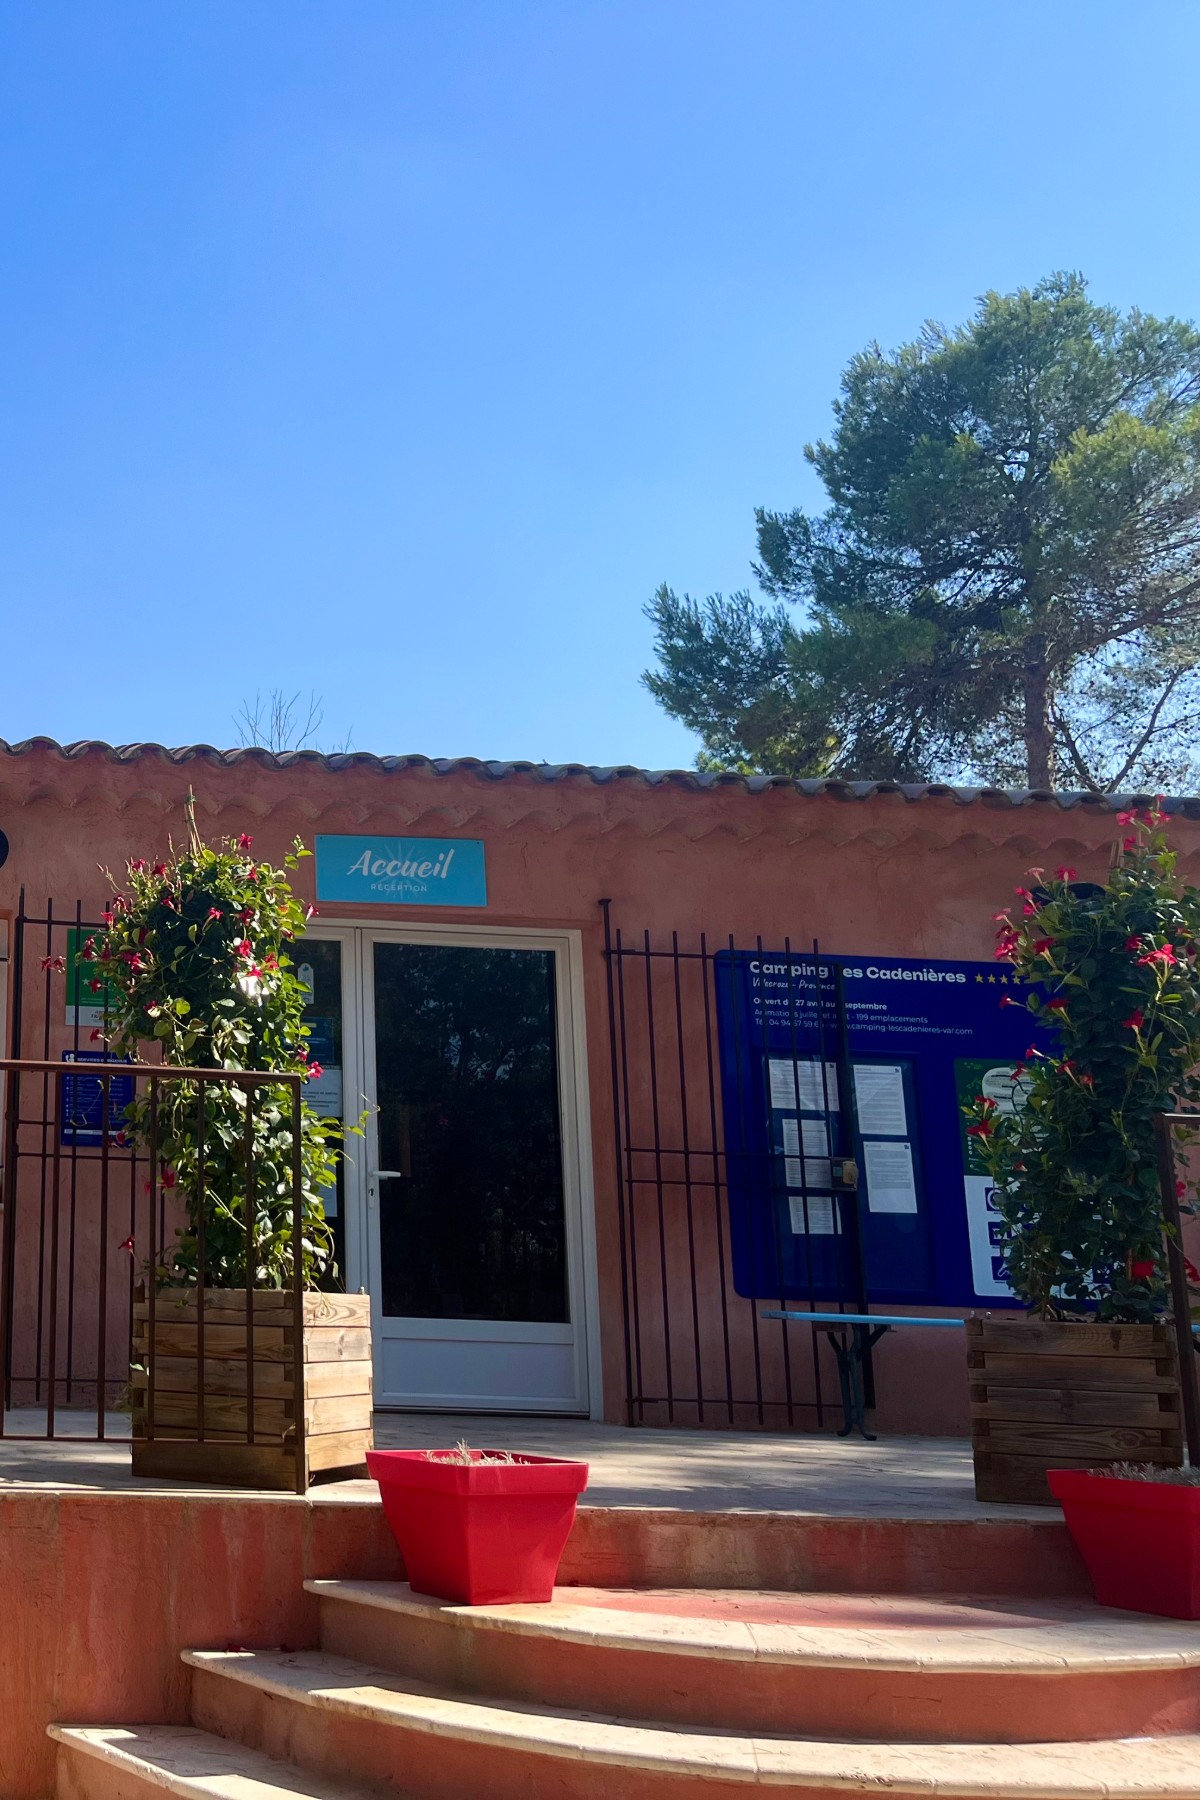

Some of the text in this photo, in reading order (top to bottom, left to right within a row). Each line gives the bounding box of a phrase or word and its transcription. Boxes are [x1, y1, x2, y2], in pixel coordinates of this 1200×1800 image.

[346, 848, 455, 879] Accueil
[370, 883, 427, 892] RECEPTION
[749, 961, 829, 979] Camping
[866, 966, 967, 983] Cadenières
[753, 997, 782, 1006] Overt
[844, 1002, 888, 1011] septembre
[870, 1014, 928, 1024] emplacements
